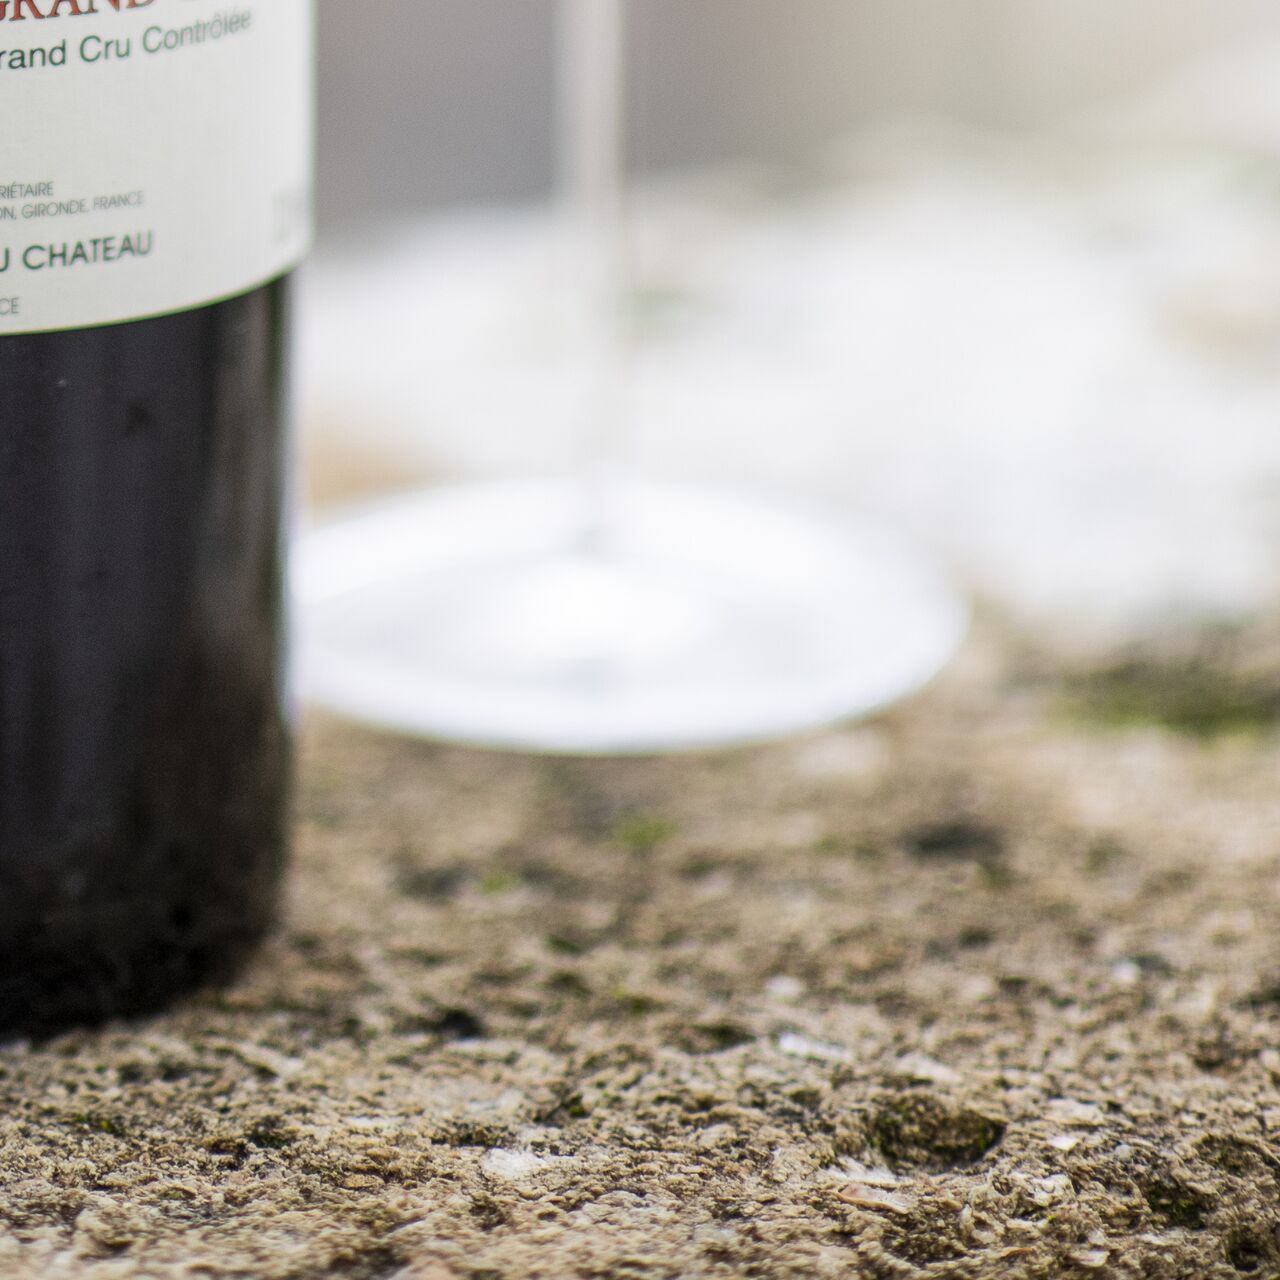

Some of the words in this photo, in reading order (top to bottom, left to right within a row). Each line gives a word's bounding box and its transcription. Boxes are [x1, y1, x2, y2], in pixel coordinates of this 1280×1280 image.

[78, 34, 131, 65] Cru
[142, 6, 253, 55] Contrôlée
[93, 190, 144, 210] FRANCE
[21, 230, 154, 271] CHATEAU
